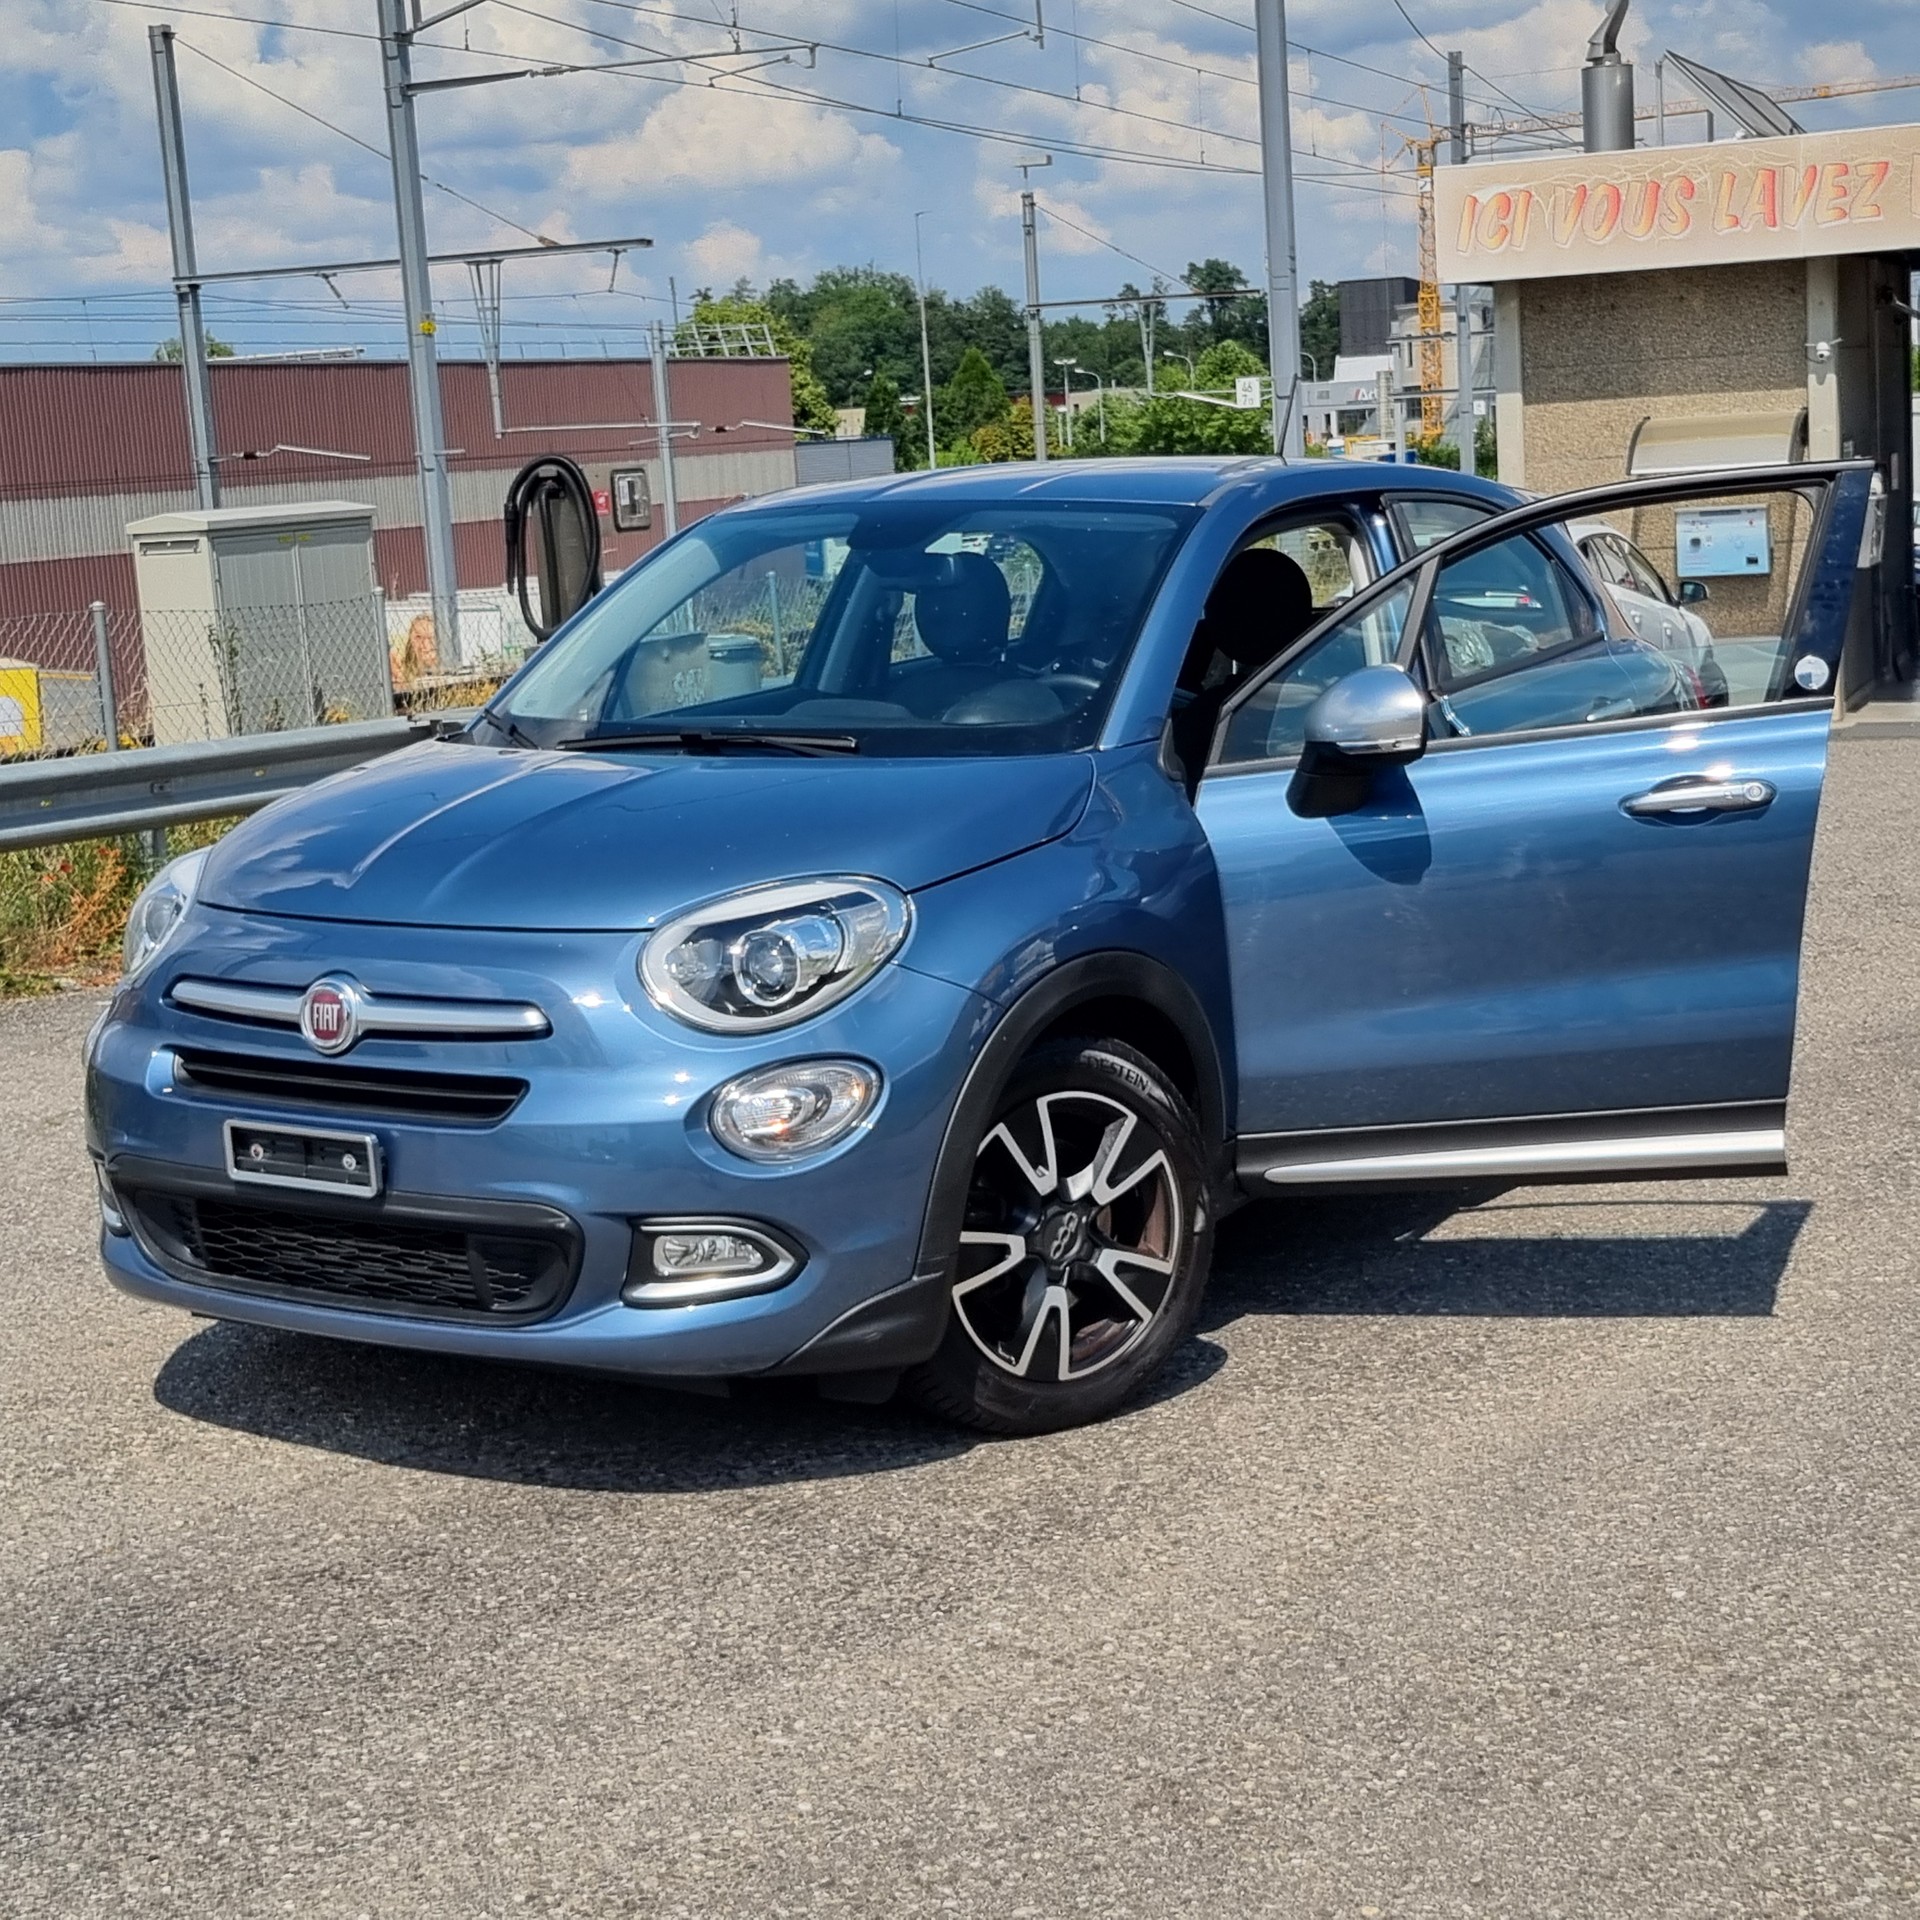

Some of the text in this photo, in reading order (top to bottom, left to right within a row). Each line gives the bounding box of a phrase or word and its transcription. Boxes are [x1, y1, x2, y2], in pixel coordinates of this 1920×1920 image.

[1456, 191, 1532, 253] ICI
[1553, 175, 1695, 246] VOUS
[1713, 161, 1890, 233] LAVEZ
[313, 1003, 341, 1031] FIAT
[1085, 1055, 1149, 1092] DESTEIN
